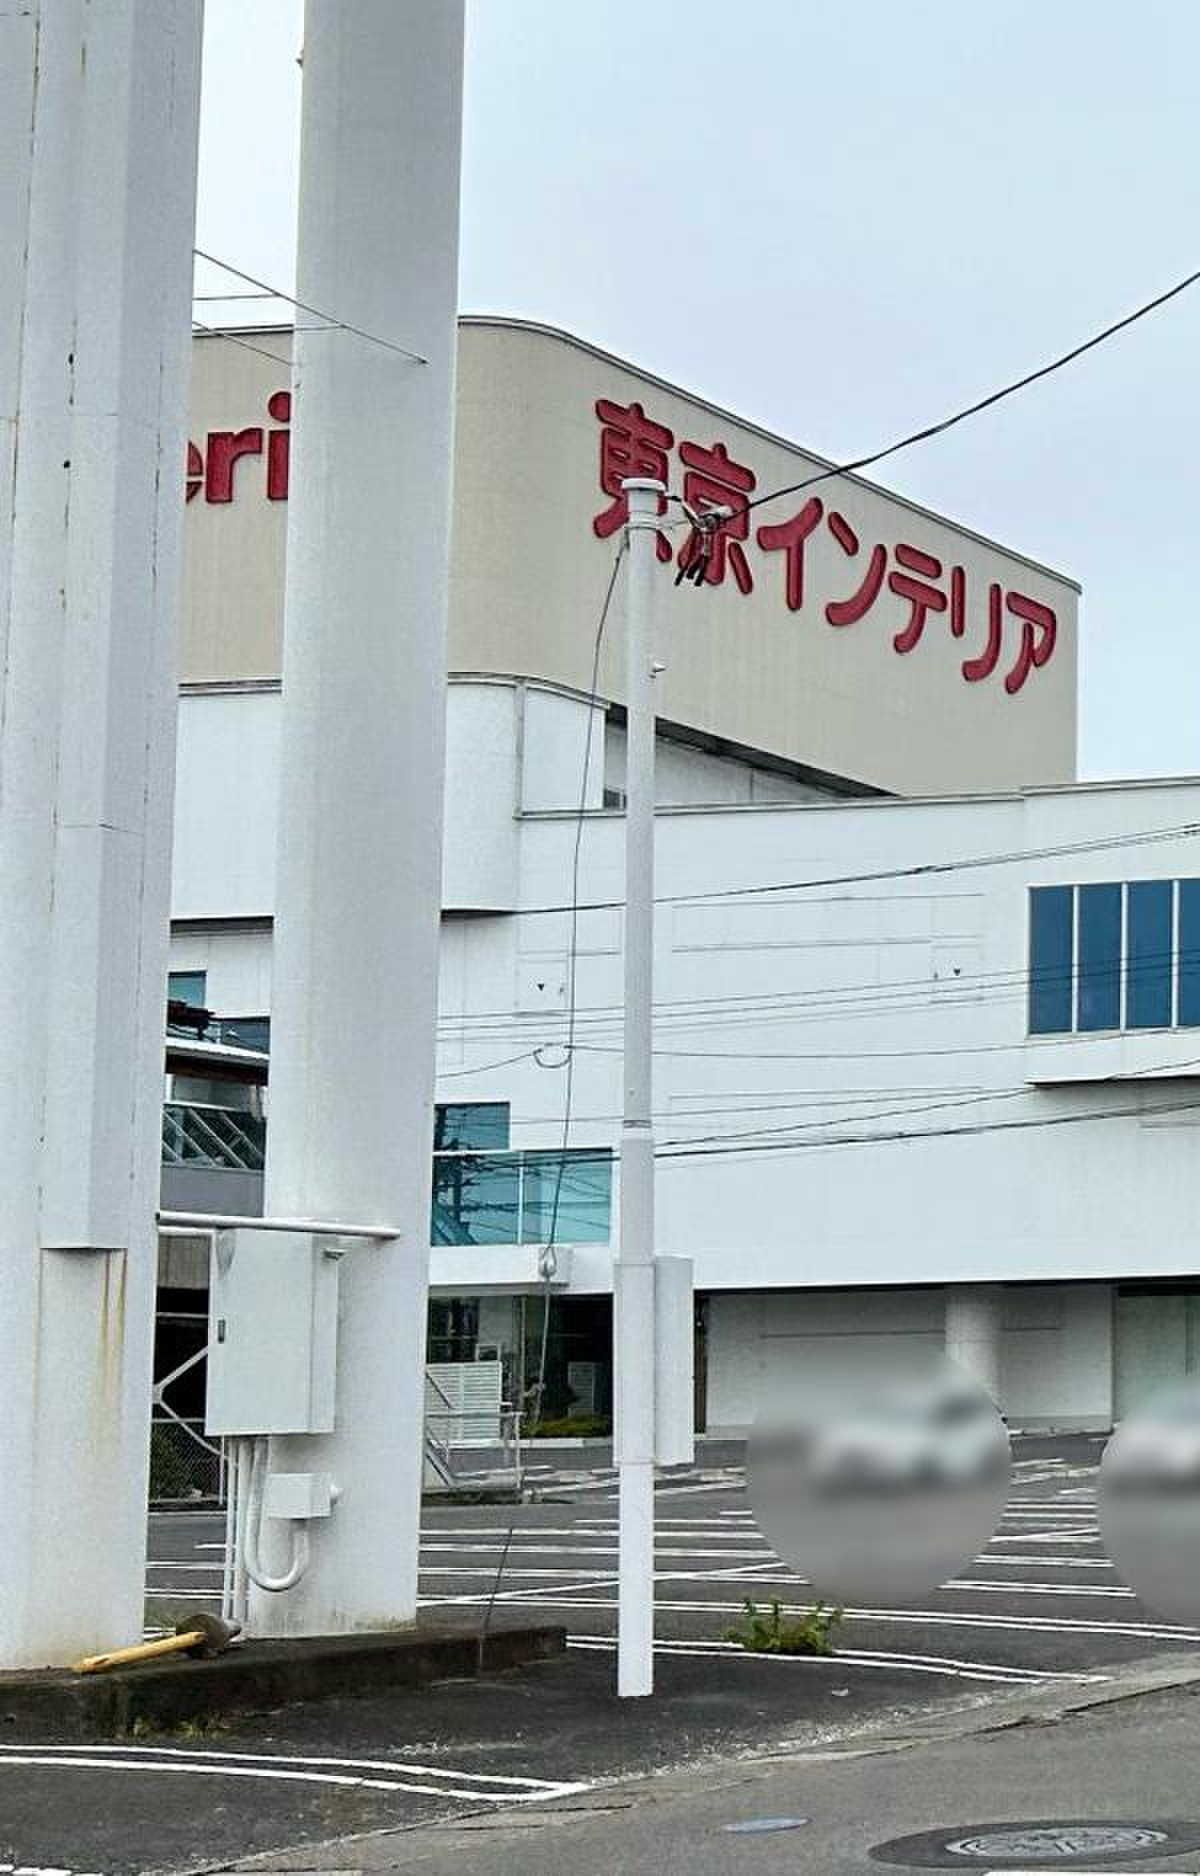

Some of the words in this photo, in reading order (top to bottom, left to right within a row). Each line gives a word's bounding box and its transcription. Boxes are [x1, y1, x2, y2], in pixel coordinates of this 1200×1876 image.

[186, 391, 291, 503] ri
[593, 398, 1057, 694] 東京インテリア
